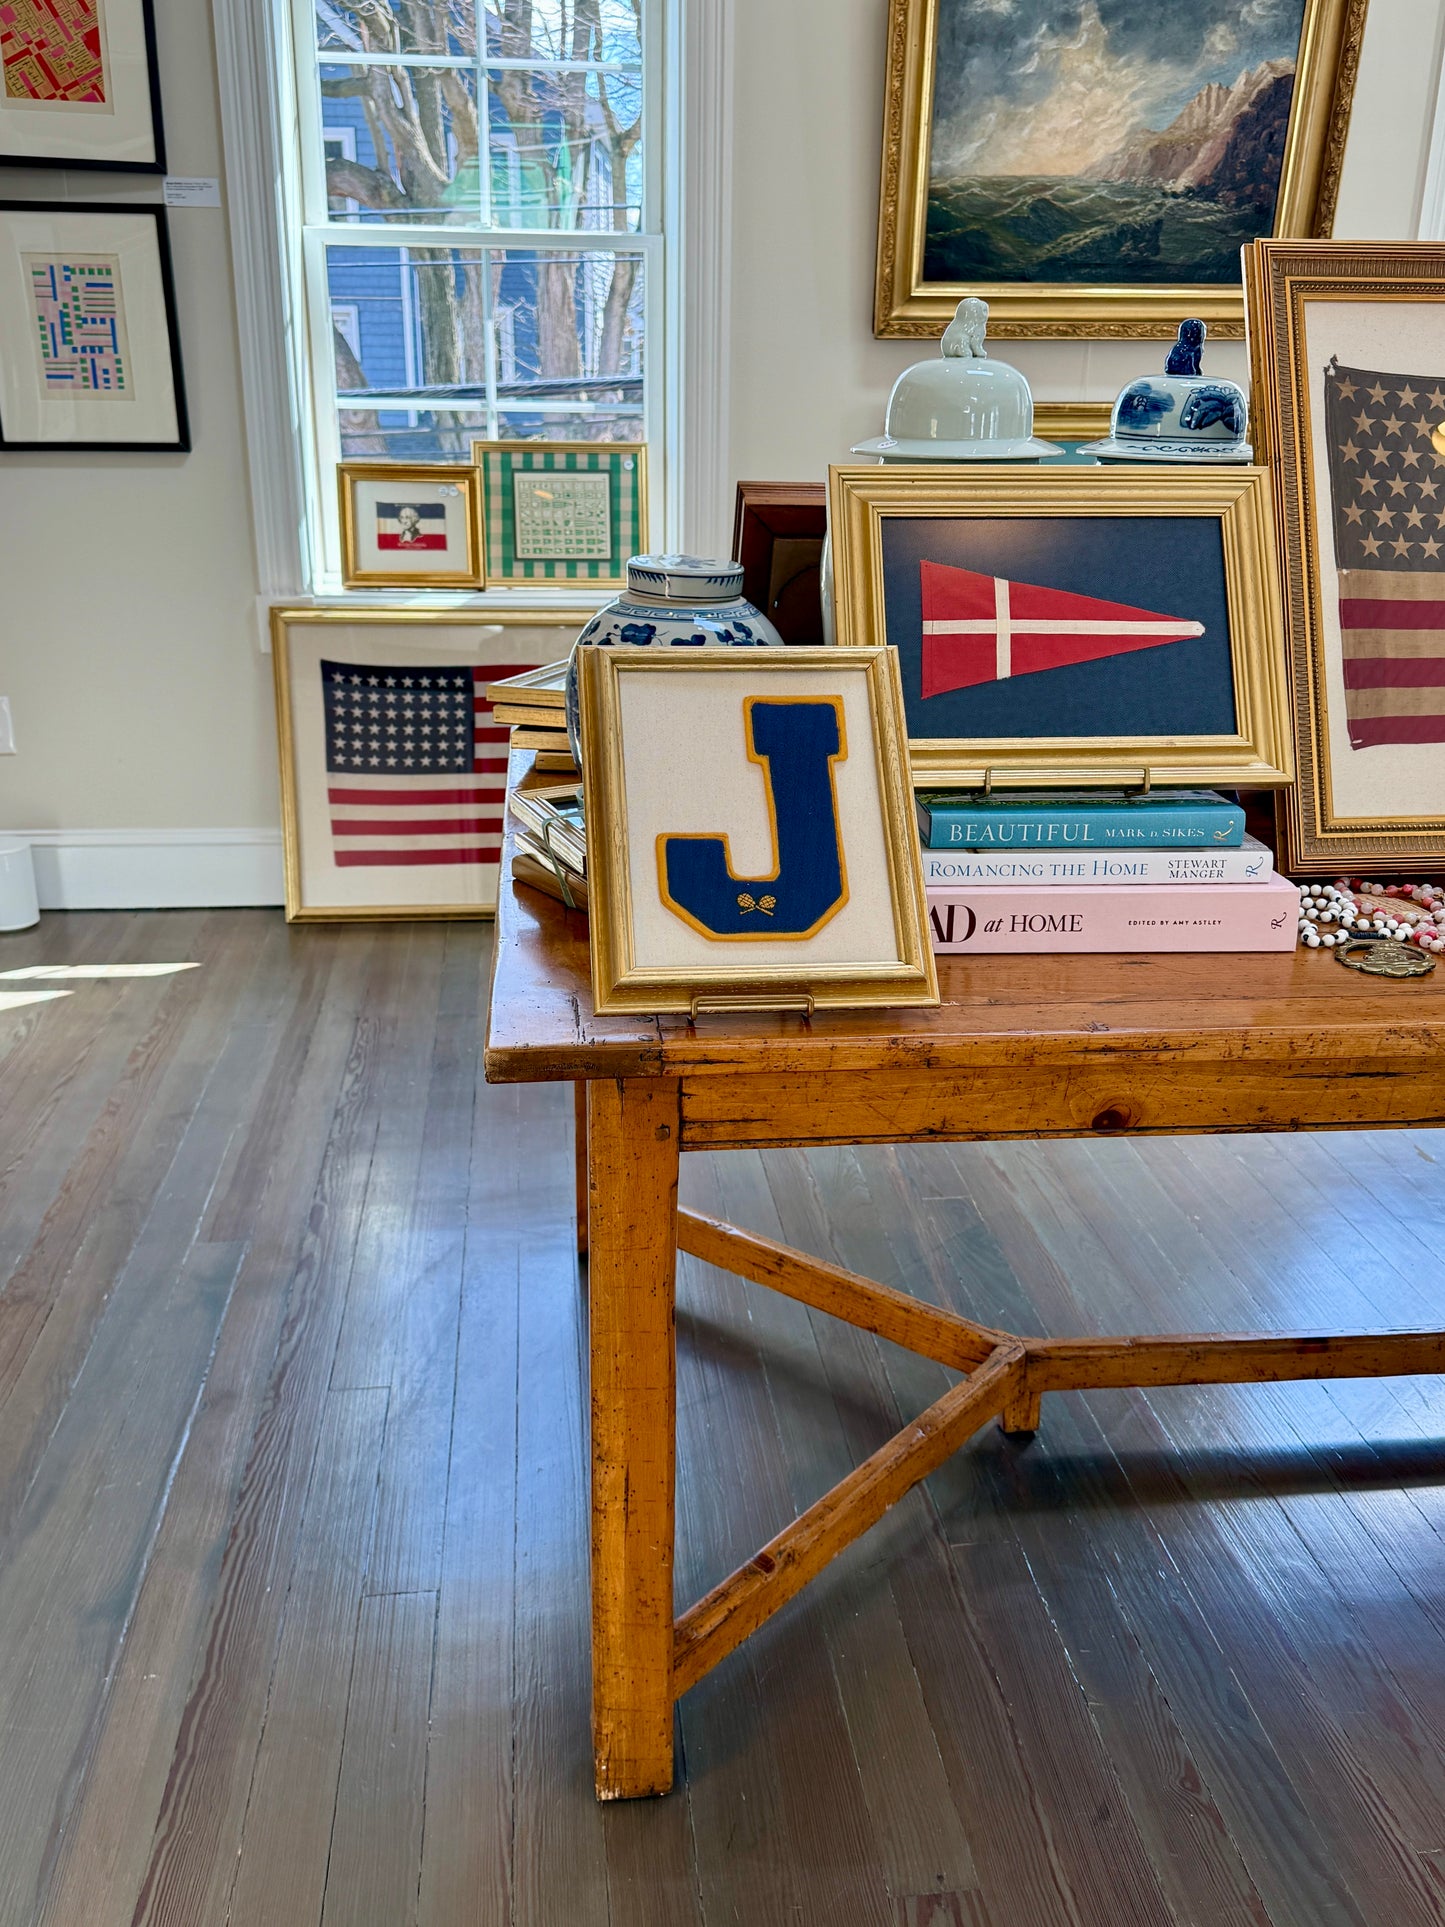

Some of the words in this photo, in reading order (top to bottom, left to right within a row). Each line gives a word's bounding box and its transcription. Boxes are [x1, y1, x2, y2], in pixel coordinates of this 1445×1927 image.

[656, 695, 849, 941] J
[950, 823, 1095, 842] BEAUTIFUL
[1105, 828, 1146, 838] MARK
[1162, 828, 1205, 837] SIKES
[1050, 864, 1086, 876] THE
[1168, 859, 1227, 869] STEWART
[1168, 869, 1224, 879] MANGER
[929, 904, 977, 943] AD
[984, 918, 1004, 933] at
[1009, 914, 1084, 933] HOME
